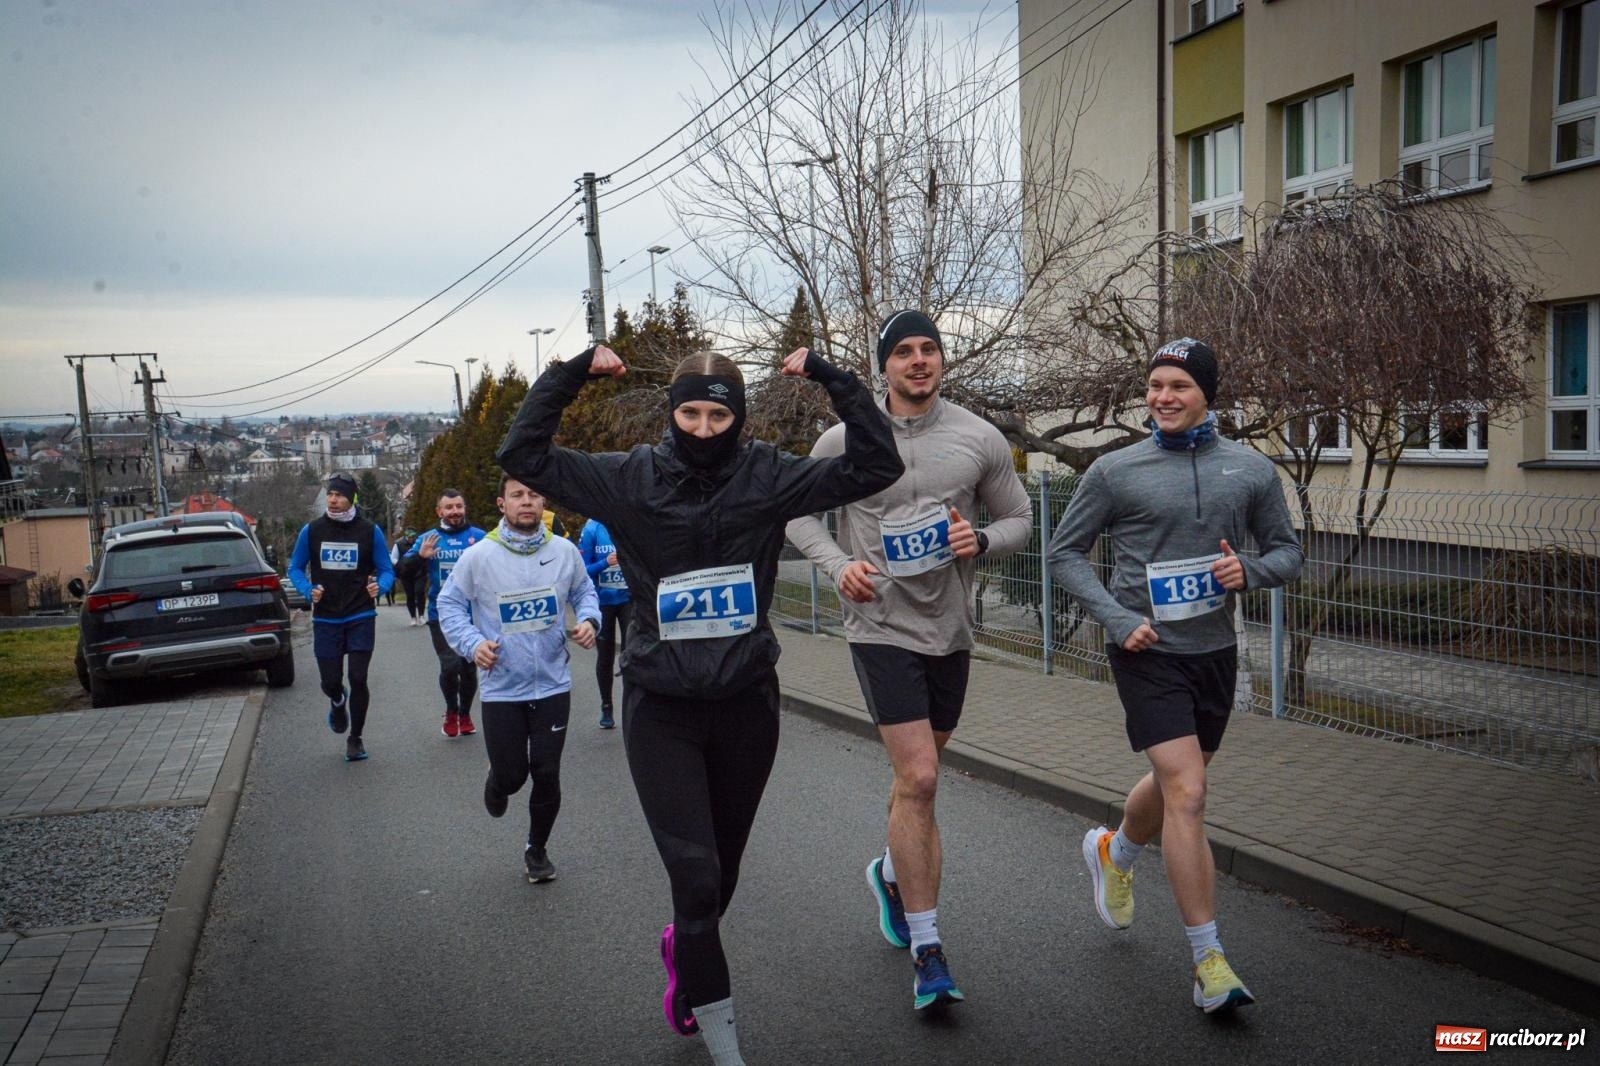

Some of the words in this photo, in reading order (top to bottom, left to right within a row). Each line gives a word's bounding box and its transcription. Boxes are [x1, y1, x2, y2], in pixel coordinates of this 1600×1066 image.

[433, 549, 464, 560] UNN
[892, 527, 942, 560] 182
[327, 550, 352, 562] 164
[1164, 573, 1216, 602] 181
[165, 599, 179, 609] OP
[183, 594, 216, 607] 1239P
[509, 599, 549, 622] 232
[675, 586, 739, 619] 211
